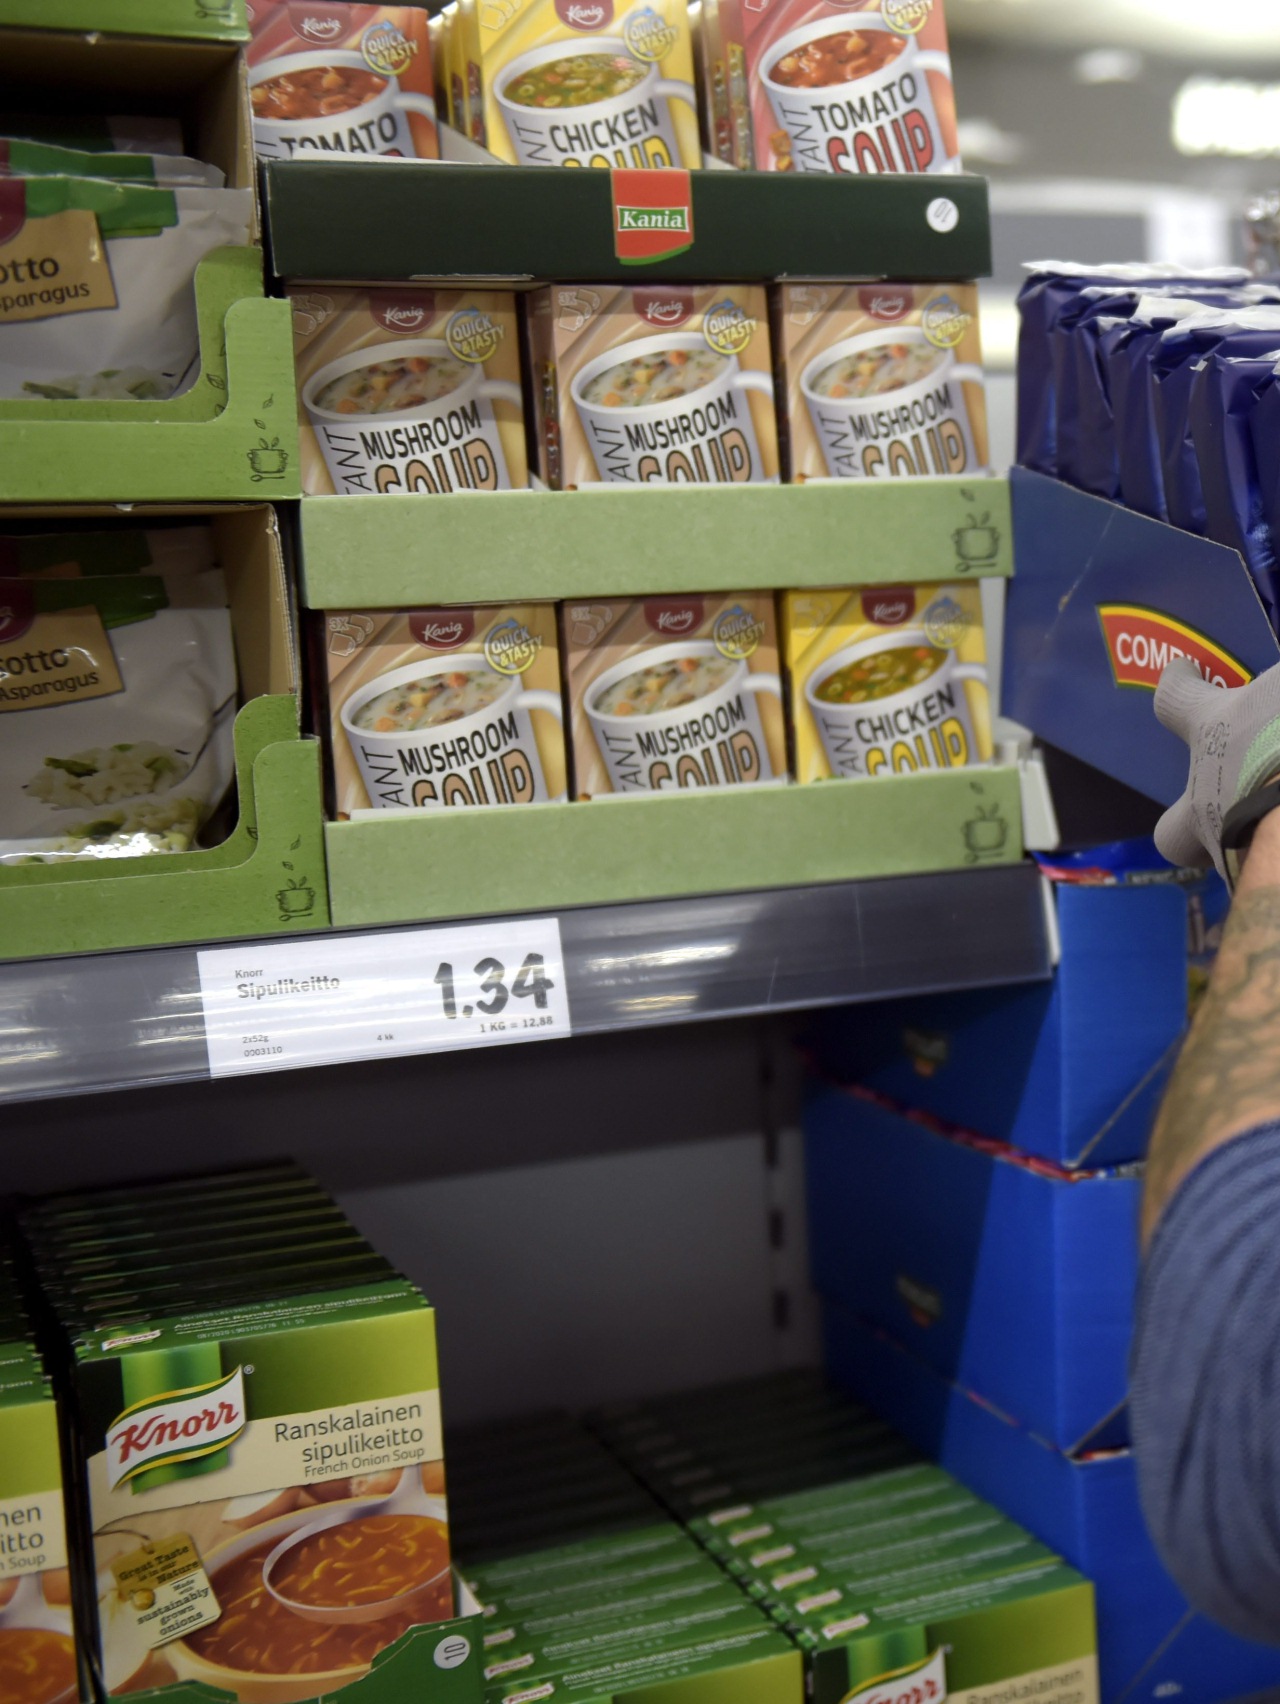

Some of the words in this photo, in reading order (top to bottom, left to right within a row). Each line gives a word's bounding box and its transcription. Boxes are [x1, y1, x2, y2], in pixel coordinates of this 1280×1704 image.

[301, 17, 341, 37] Kania
[567, 5, 604, 25] Kania
[368, 28, 405, 54] QUICK
[811, 72, 917, 133] TOMATO
[550, 98, 659, 153] CHICKEN
[622, 210, 683, 228] Kania
[0, 282, 90, 312] paragus
[646, 301, 683, 321] Kania
[383, 306, 424, 327] Kania
[453, 316, 492, 341] QUICK
[462, 326, 504, 354] &TASTY
[624, 391, 737, 452] MUSHROOM
[849, 382, 954, 440] MUSHROOM
[360, 400, 482, 460] MUSHROOM
[328, 617, 350, 632] 3X
[422, 622, 463, 643] Kania
[658, 610, 694, 630] Kania
[491, 626, 531, 654] QUICK
[500, 636, 543, 667] &TASTY
[0, 648, 69, 678] otto
[636, 695, 745, 758] MUSHROOM
[855, 683, 955, 744] CHICKEN
[398, 711, 519, 776] MUSHROOM
[235, 969, 263, 979] Knorr
[237, 975, 340, 1000] Sipulikeitto
[434, 953, 554, 1019] 1.34
[242, 1034, 269, 1044] 2x52g
[480, 1023, 486, 1033] 1
[490, 1021, 506, 1031] KG
[111, 1402, 239, 1464] Knorr
[275, 1404, 422, 1442] Ranskalainen
[302, 1427, 423, 1469] sipulikeitto
[305, 1463, 349, 1478] French
[351, 1452, 394, 1469] Onion
[393, 1446, 425, 1464] Soup
[9, 1554, 46, 1570] Soup
[119, 1561, 154, 1581] Great
[154, 1546, 189, 1564] Taste
[157, 1560, 199, 1584] Nature
[137, 1587, 209, 1625] sustainably
[160, 1604, 195, 1626] grown
[160, 1611, 203, 1636] onions
